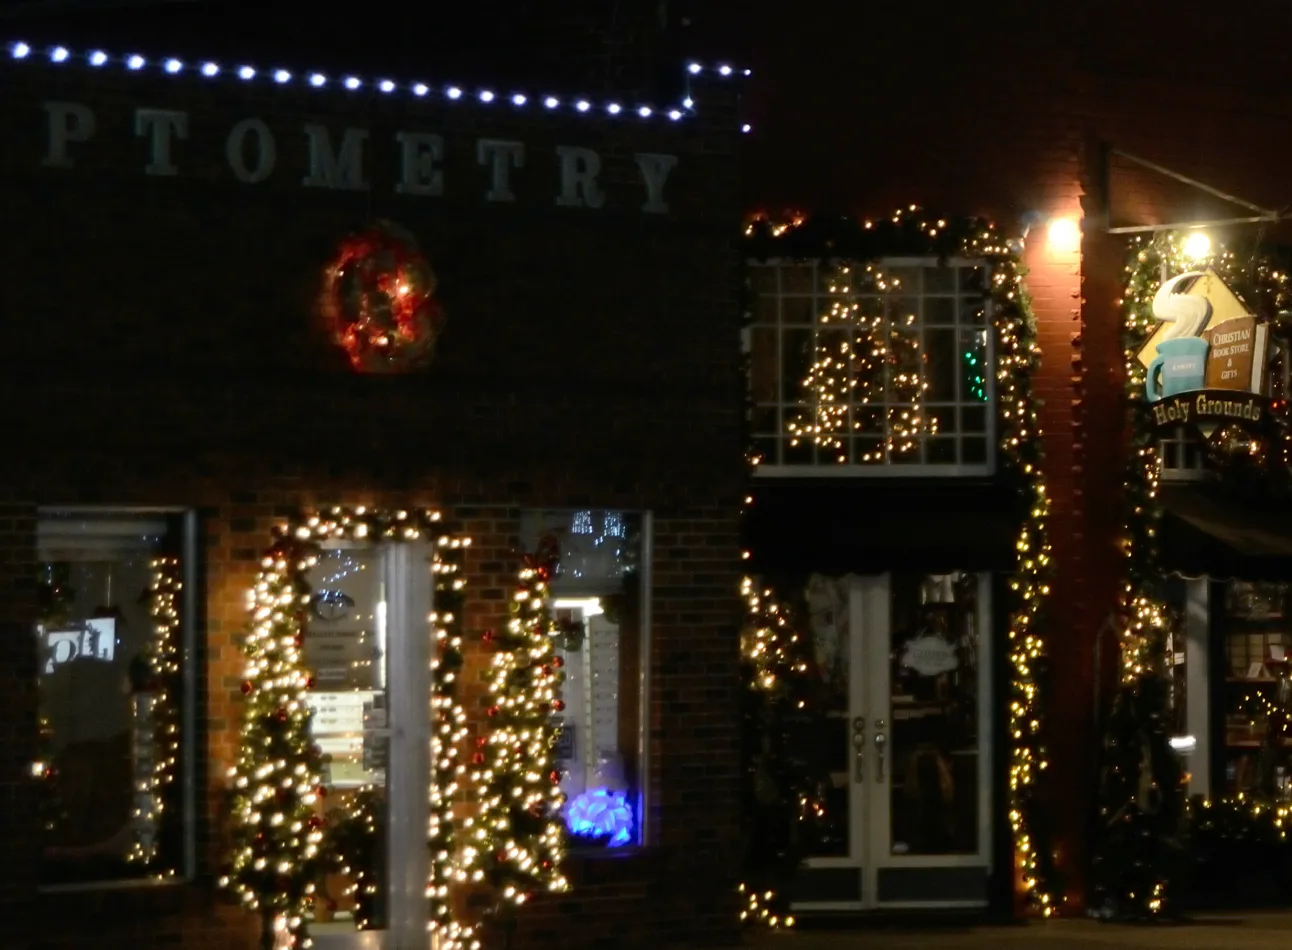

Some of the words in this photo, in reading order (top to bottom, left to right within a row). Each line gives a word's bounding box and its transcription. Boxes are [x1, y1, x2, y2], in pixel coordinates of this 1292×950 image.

[41, 100, 679, 214] PTOMETRY
[1213, 329, 1252, 346] CHRISTIAN
[1213, 347, 1230, 358] BOOK
[1230, 343, 1249, 355] STORE
[1227, 358, 1233, 367] &
[1221, 369, 1238, 380] GIFTS
[1153, 398, 1190, 426] Holy
[1195, 394, 1261, 421] Grounds
